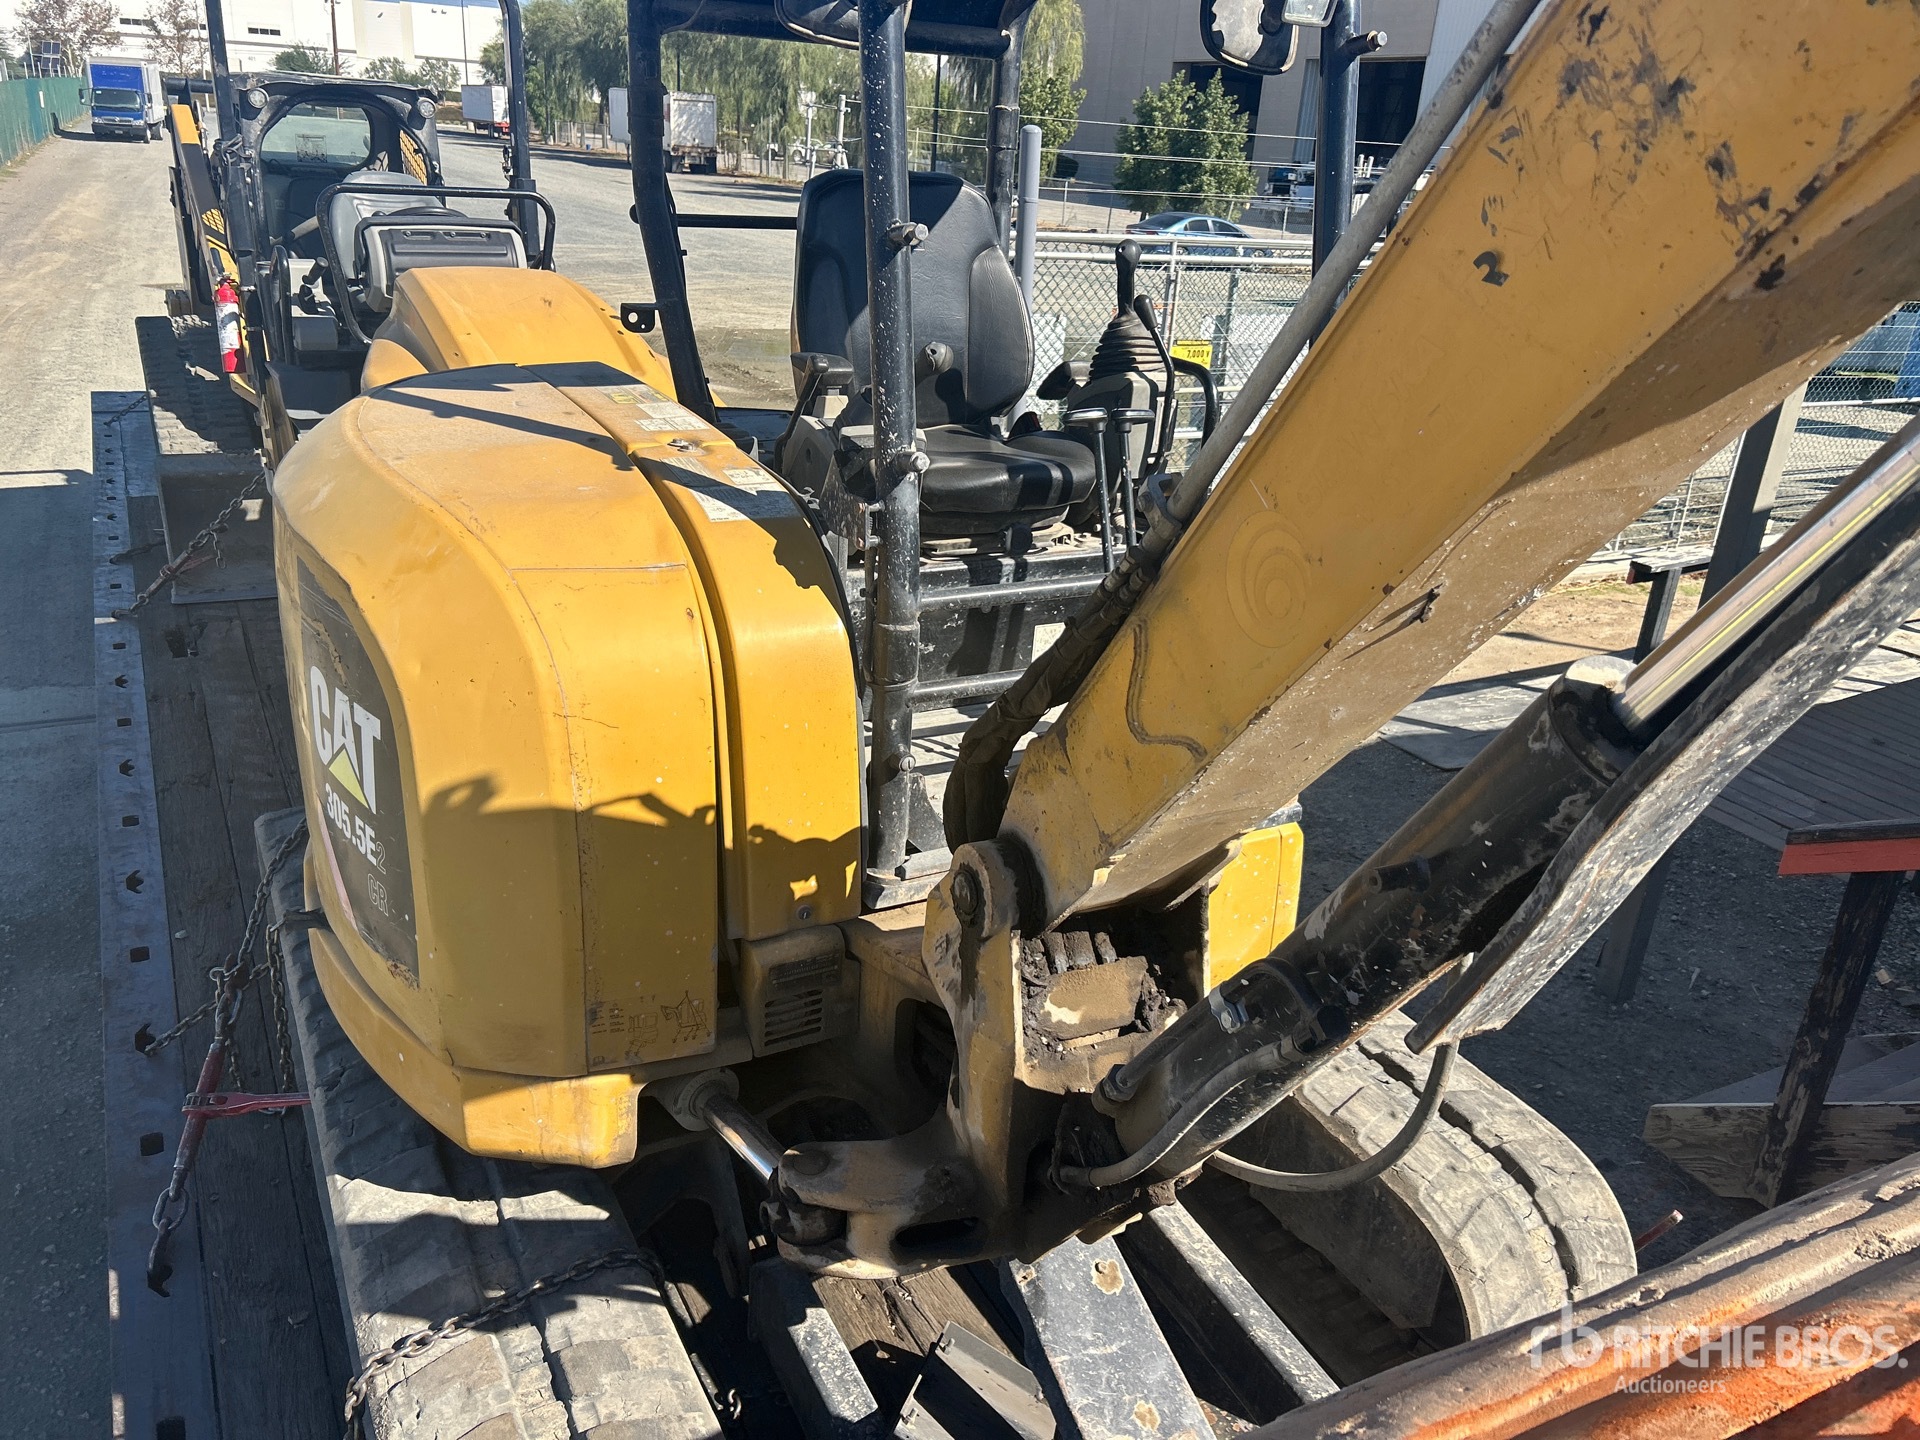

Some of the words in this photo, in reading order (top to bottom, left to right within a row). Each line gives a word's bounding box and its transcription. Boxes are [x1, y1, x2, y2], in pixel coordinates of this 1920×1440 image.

[1186, 349, 1205, 359] 7,000
[310, 665, 381, 815] CAT
[366, 872, 389, 917] CR
